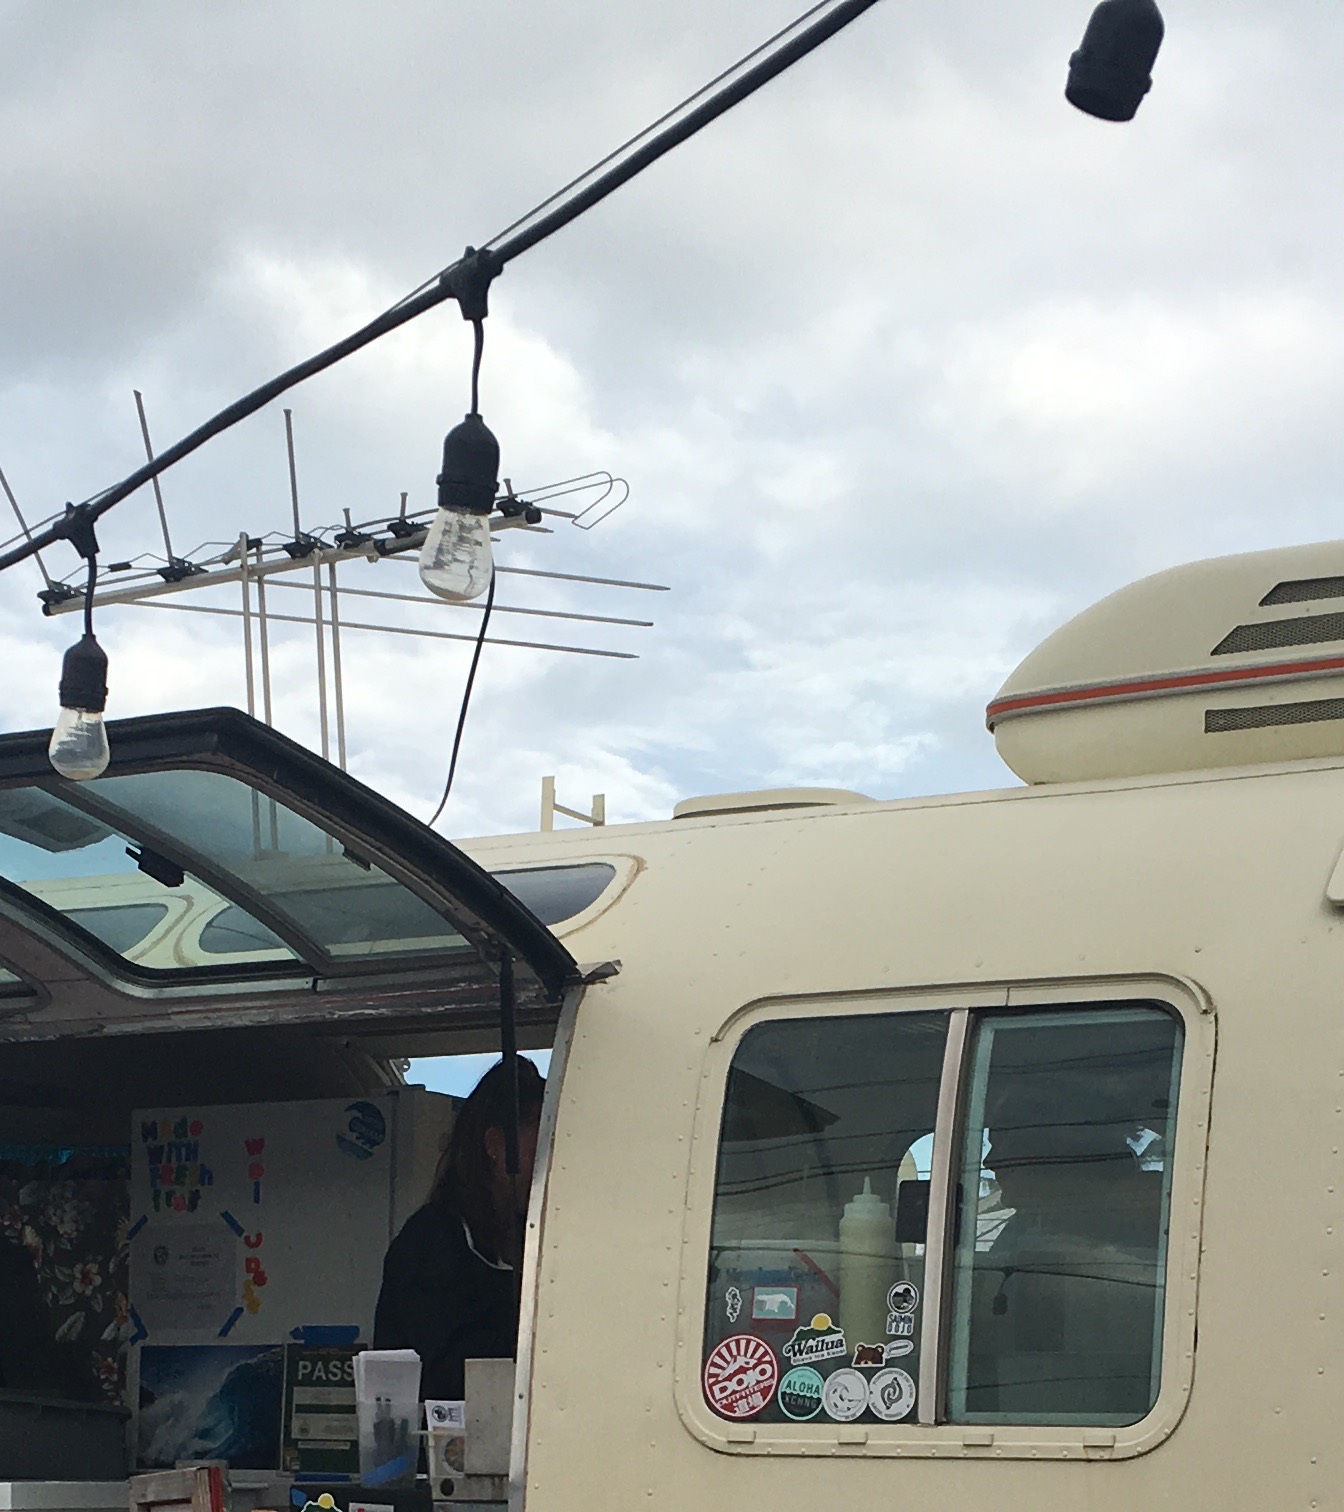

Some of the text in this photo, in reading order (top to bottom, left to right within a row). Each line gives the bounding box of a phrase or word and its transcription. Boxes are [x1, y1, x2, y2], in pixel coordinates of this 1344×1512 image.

[147, 1140, 199, 1165] WITH
[786, 1337, 844, 1358] Wailua
[712, 1364, 773, 1400] DOJO
[785, 1379, 821, 1396] ALOHA
